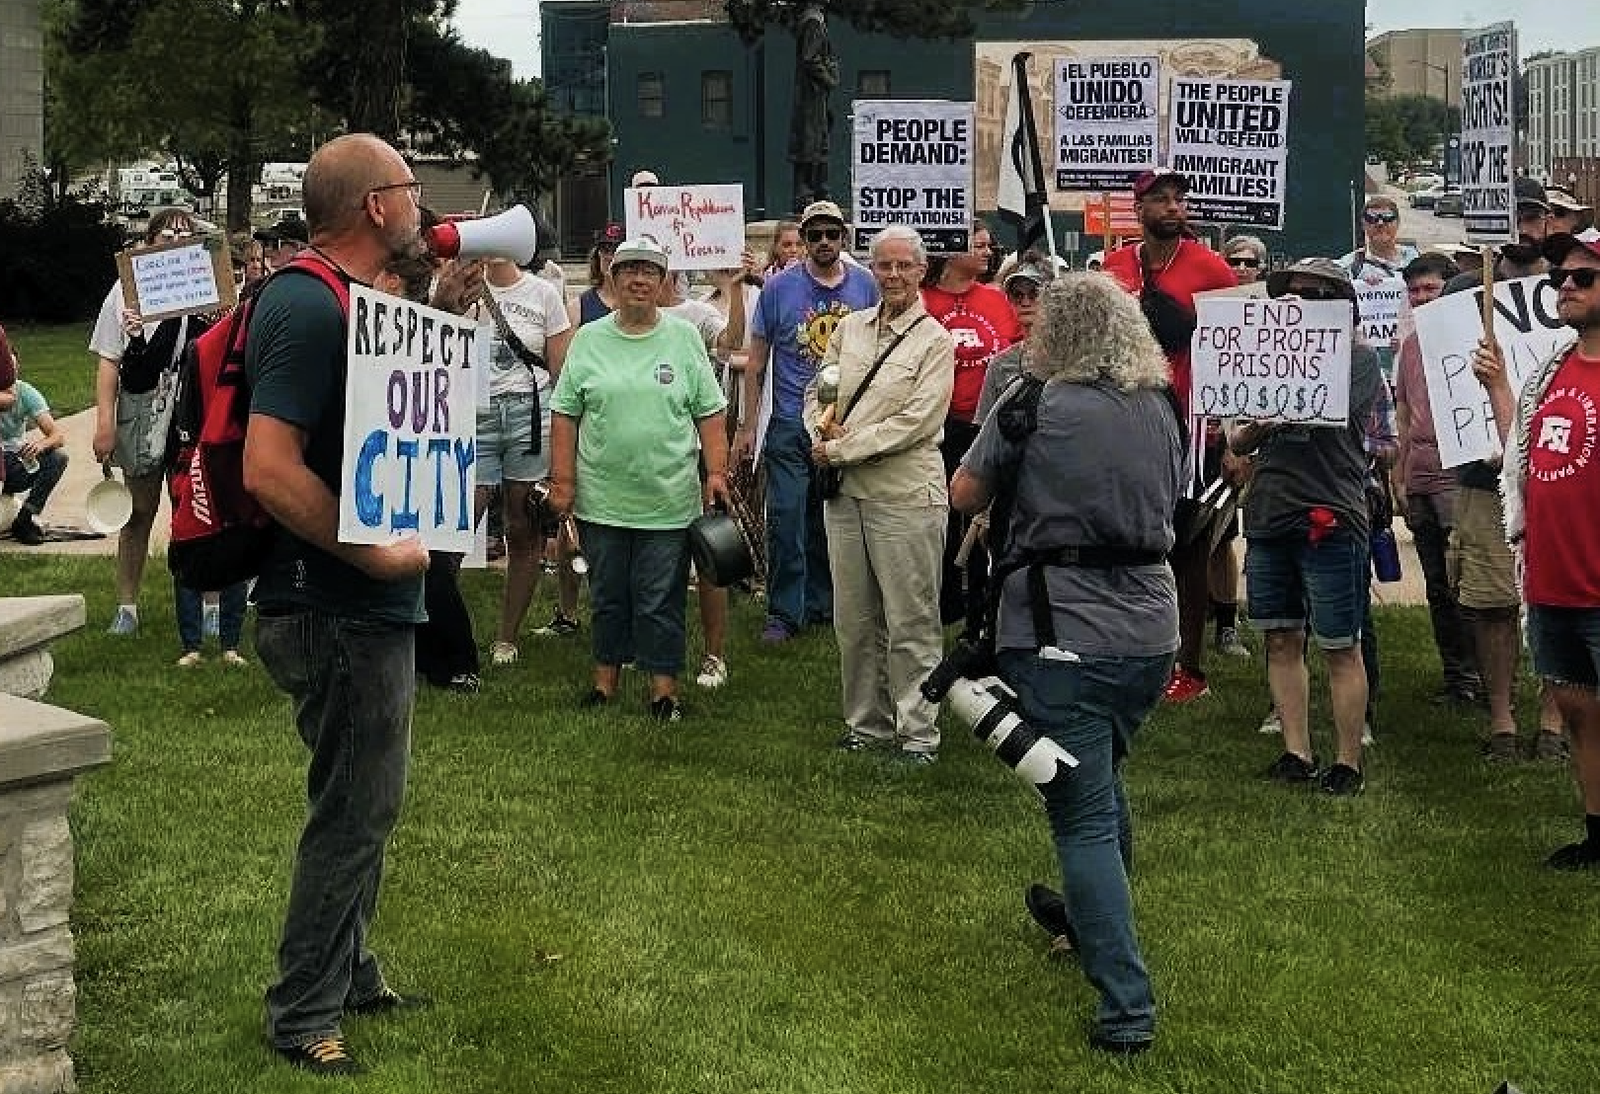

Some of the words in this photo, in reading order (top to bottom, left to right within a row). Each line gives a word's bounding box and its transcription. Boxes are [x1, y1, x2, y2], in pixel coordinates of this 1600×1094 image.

[1090, 61, 1152, 79] PUEBLO
[1070, 80, 1143, 105] UNIDO
[1177, 83, 1211, 100] THE
[1217, 85, 1282, 104] PEOPLE
[1176, 101, 1281, 132] UNITED
[876, 118, 967, 142] PEOPLE
[1060, 135, 1069, 147] A
[1072, 135, 1095, 147] LAS
[1097, 134, 1153, 148] FAMILIAS
[1175, 128, 1213, 144] WILL
[1216, 131, 1279, 149] DEFEND
[860, 142, 967, 165] DEMAND:
[1060, 148, 1153, 163] MIGRANTES!
[1174, 154, 1279, 177] IMMIGRANT
[859, 186, 918, 209] STOP
[922, 187, 965, 209] THE
[1186, 174, 1277, 199] AMILIES!
[860, 210, 965, 225] DEPORTATIONS!
[1243, 303, 1303, 327] END
[355, 296, 476, 369] RESPECT
[1199, 326, 1241, 350] FOR
[1256, 328, 1342, 354] PROFIT
[1218, 352, 1322, 380] PRISONS
[387, 367, 449, 434] OUR
[355, 429, 476, 533] CITY
